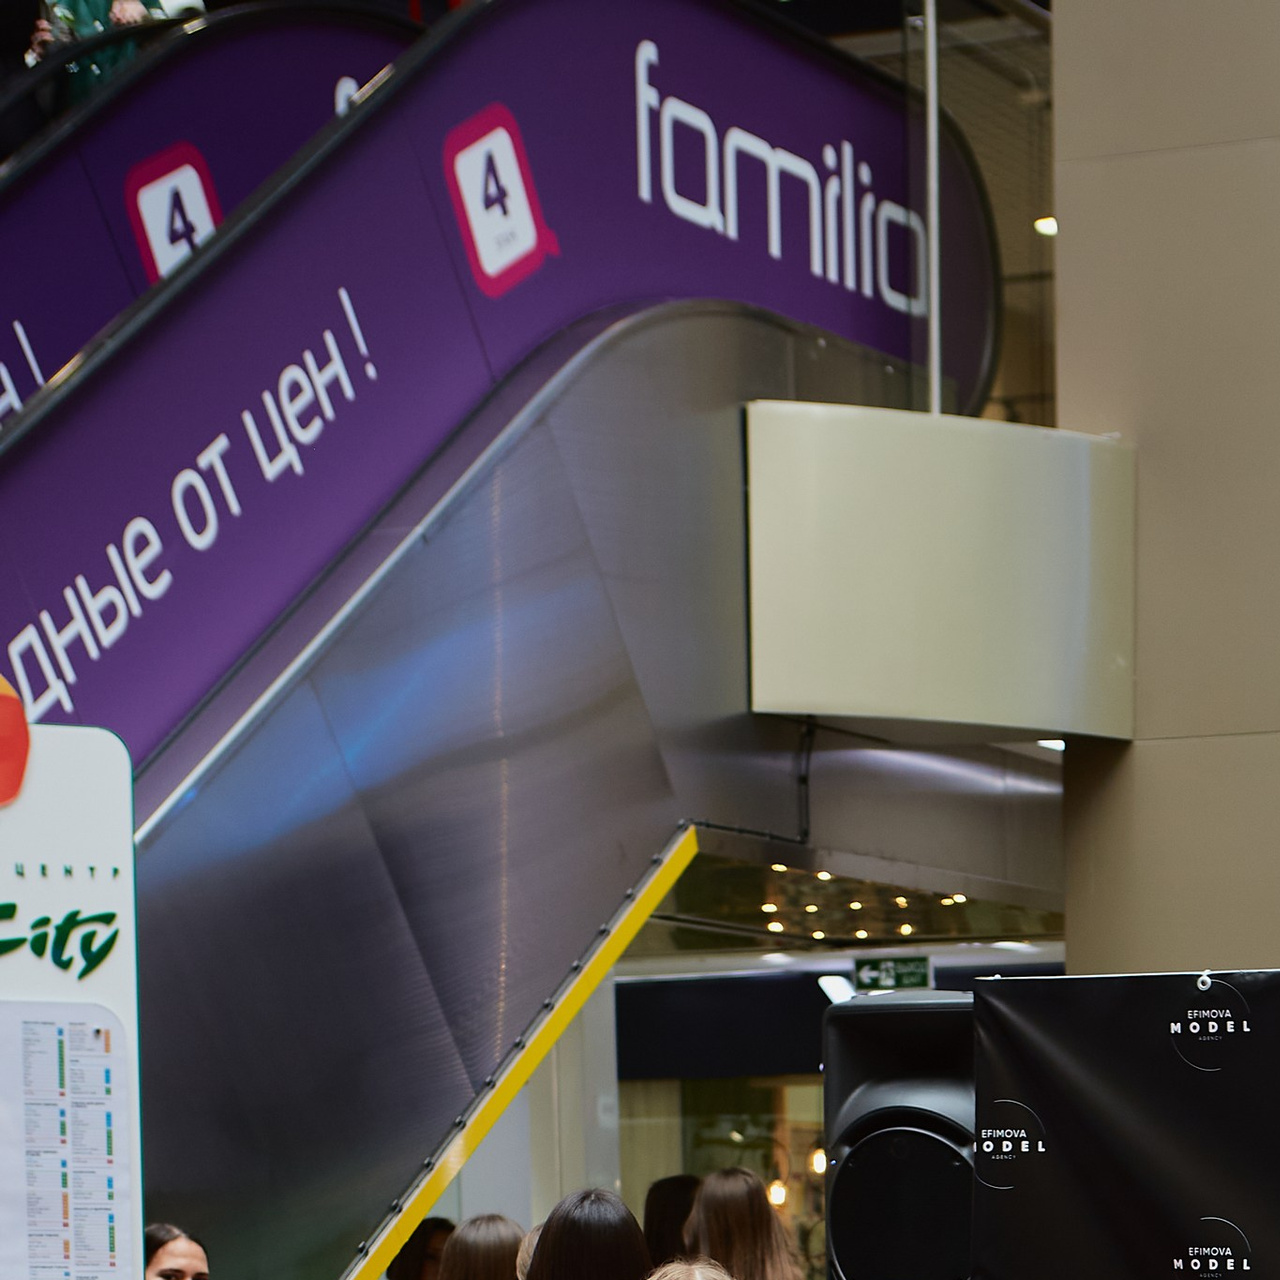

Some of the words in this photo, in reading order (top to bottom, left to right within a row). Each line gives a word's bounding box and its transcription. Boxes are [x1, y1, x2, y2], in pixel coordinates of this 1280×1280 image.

[483, 149, 509, 217] 4
[168, 185, 196, 254] 4
[1188, 1010, 1231, 1019] EFIMOVA
[1171, 1021, 1250, 1033] MODEL
[982, 1129, 1026, 1138] EFIMOVA
[1189, 1247, 1232, 1256] EFIMOVA
[1174, 1259, 1250, 1270] MODEL
